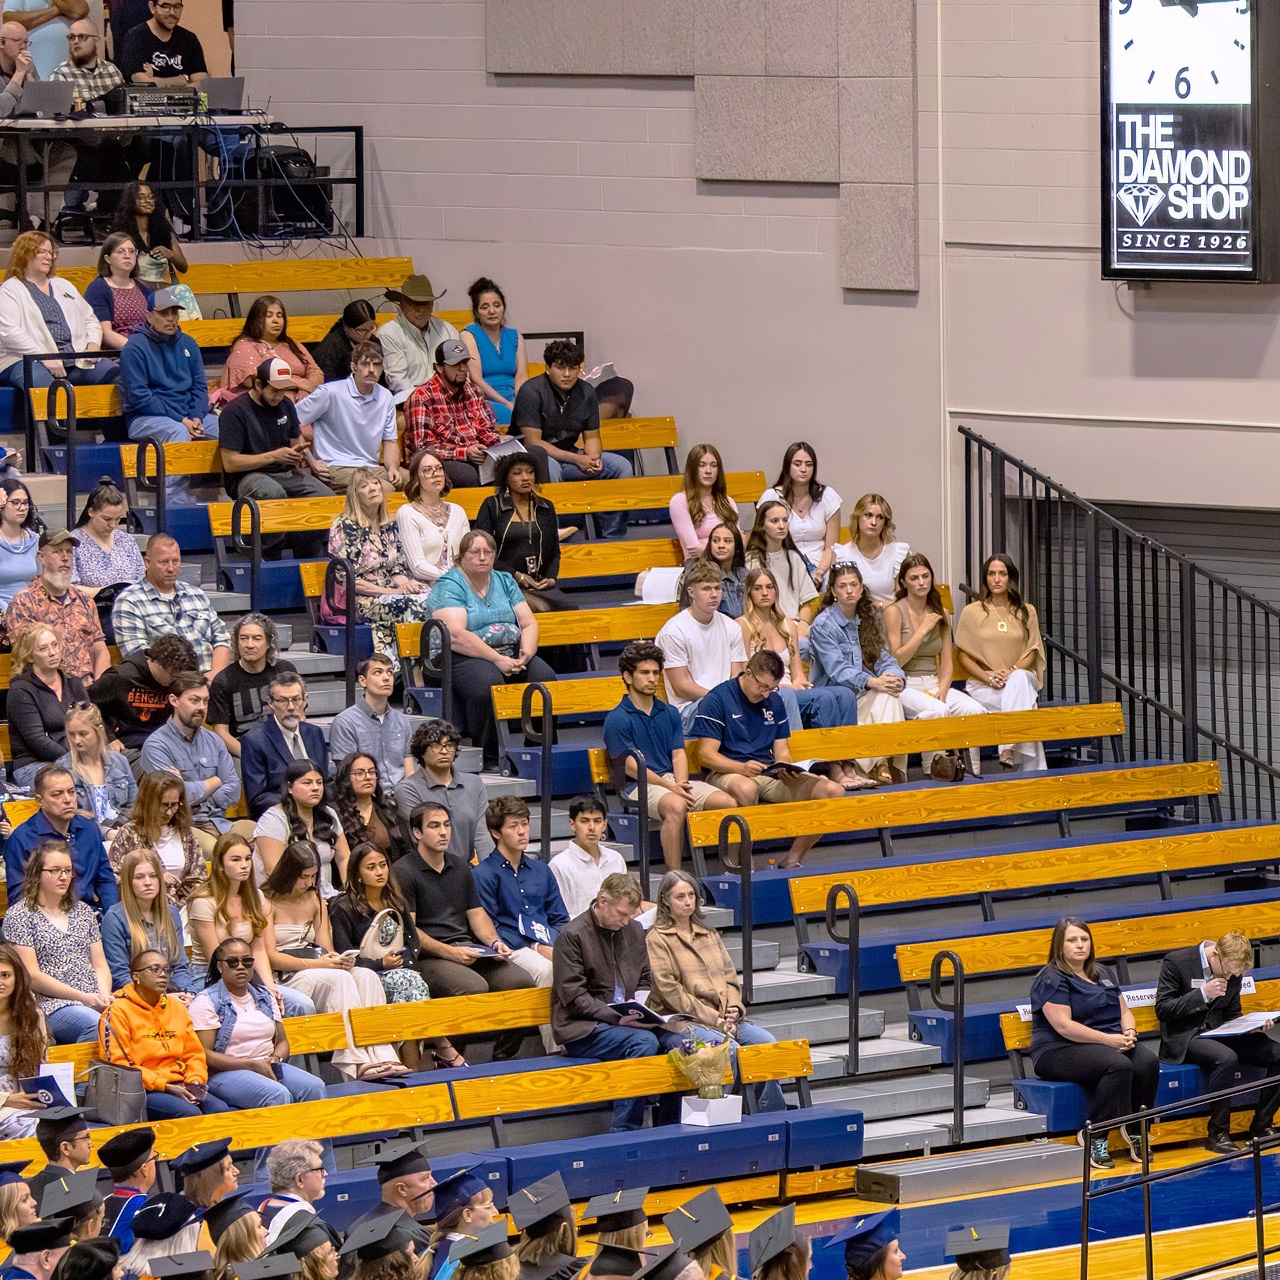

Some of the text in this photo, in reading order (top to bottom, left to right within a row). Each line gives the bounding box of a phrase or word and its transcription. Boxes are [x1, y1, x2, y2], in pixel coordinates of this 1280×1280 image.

[1174, 67, 1191, 99] 6
[1118, 114, 1174, 149] THE
[1118, 150, 1250, 184] DIAMOND
[1168, 184, 1249, 219] SHOP
[1123, 234, 1247, 249] SINCE 1926
